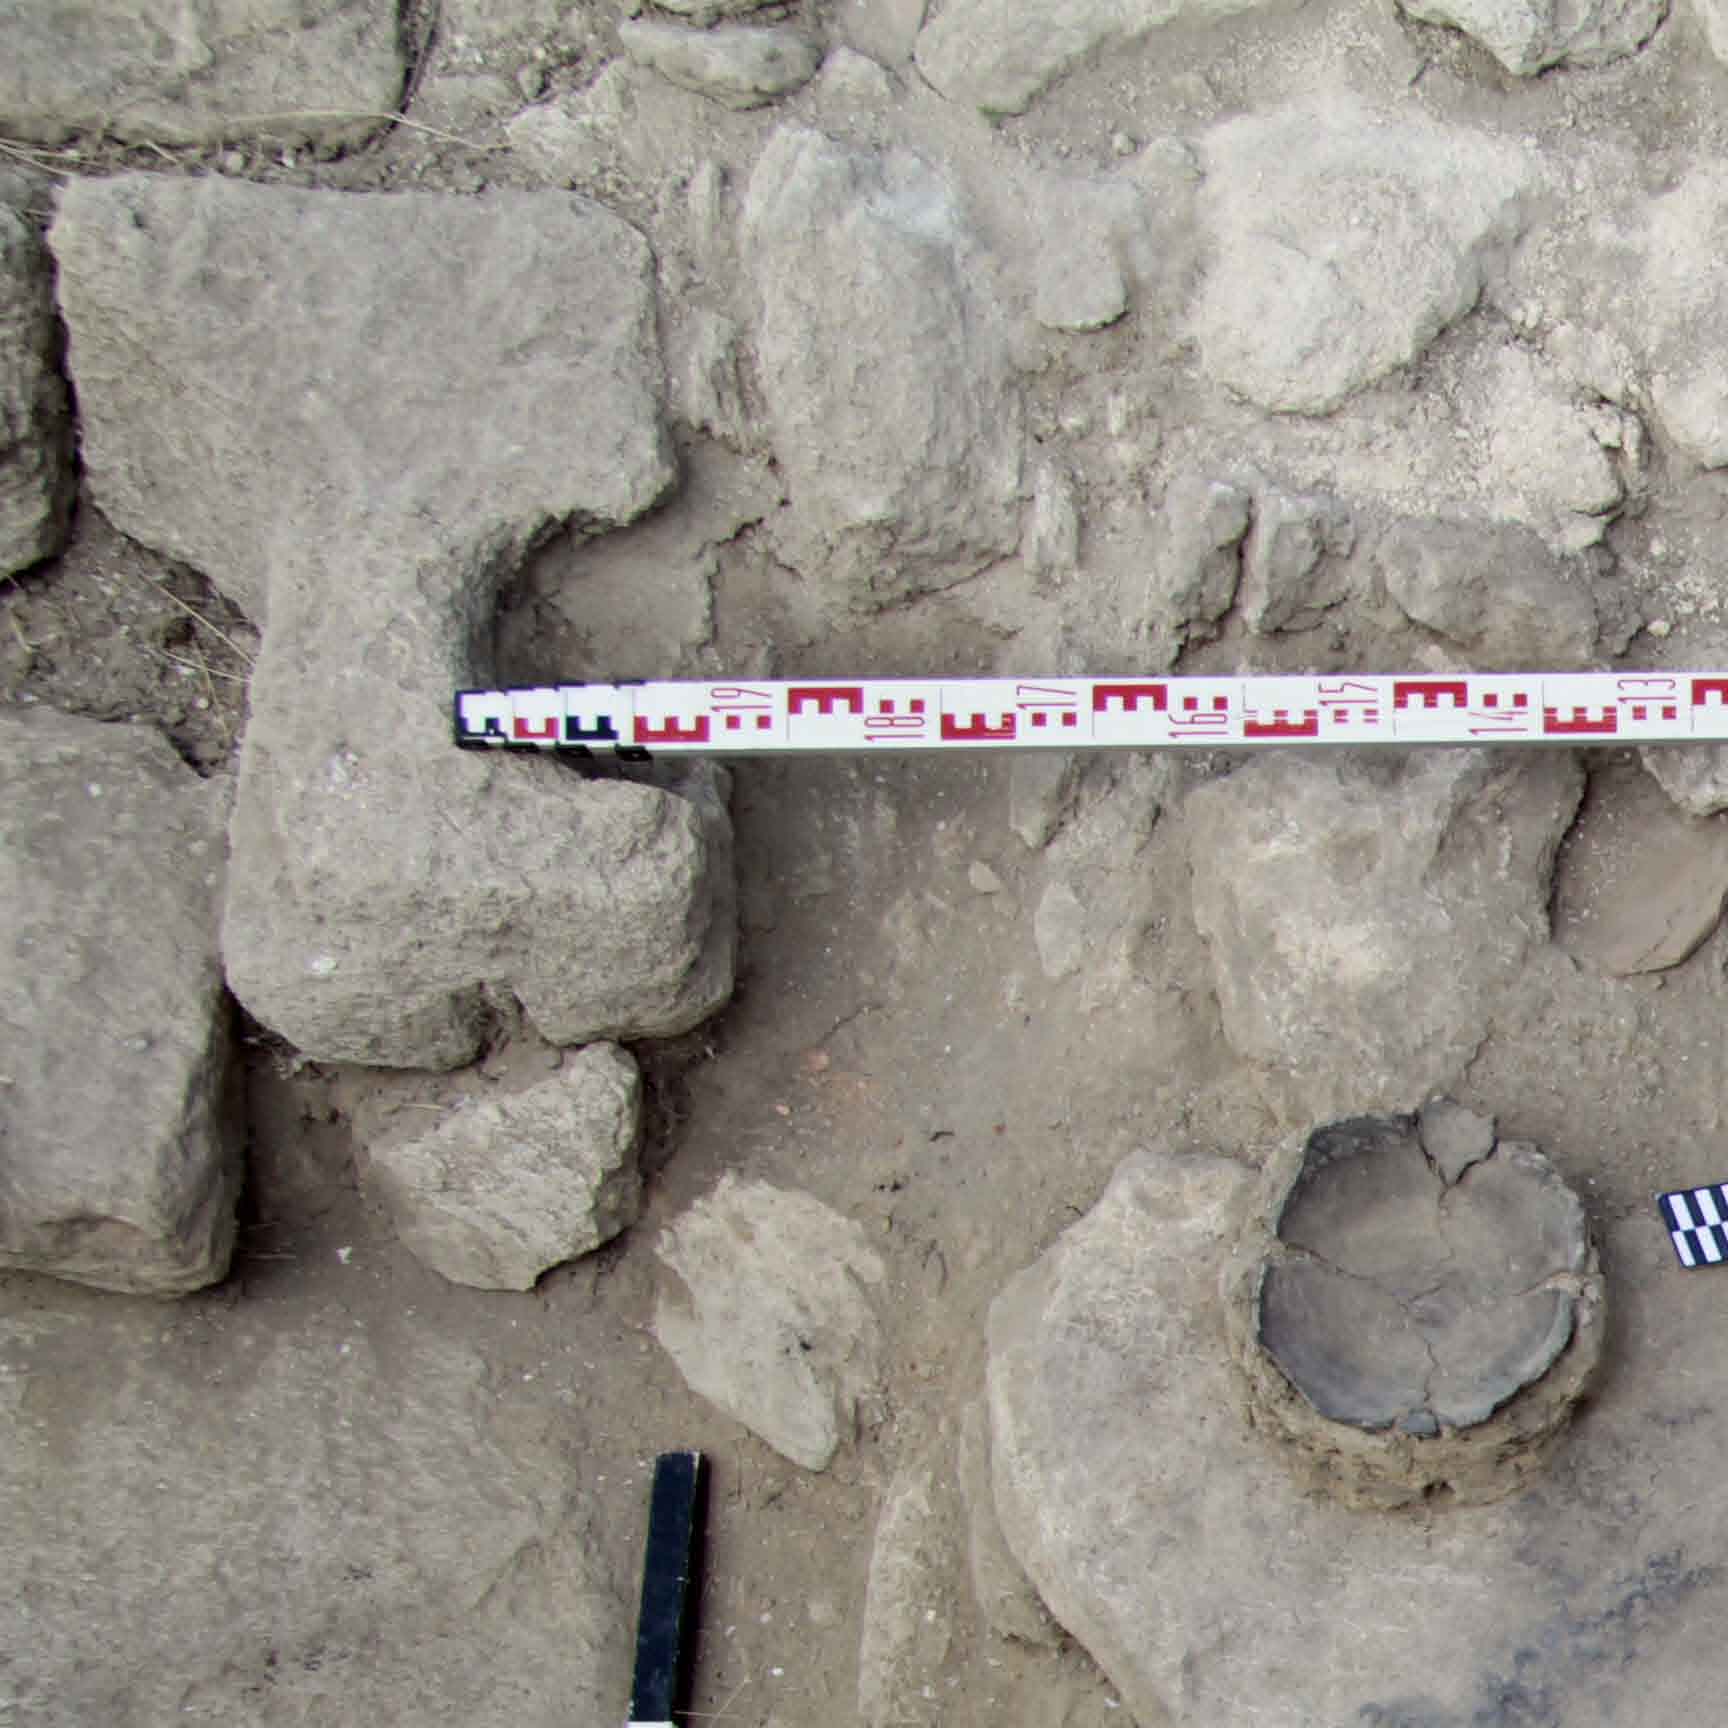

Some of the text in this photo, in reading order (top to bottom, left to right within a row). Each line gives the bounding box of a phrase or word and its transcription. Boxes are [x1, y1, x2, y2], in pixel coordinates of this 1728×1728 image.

[710, 687, 772, 711] 19
[1016, 684, 1077, 710] 17
[1318, 681, 1378, 706] 15
[1617, 679, 1676, 703] 13
[863, 716, 926, 742] 18
[1168, 713, 1229, 738] 16
